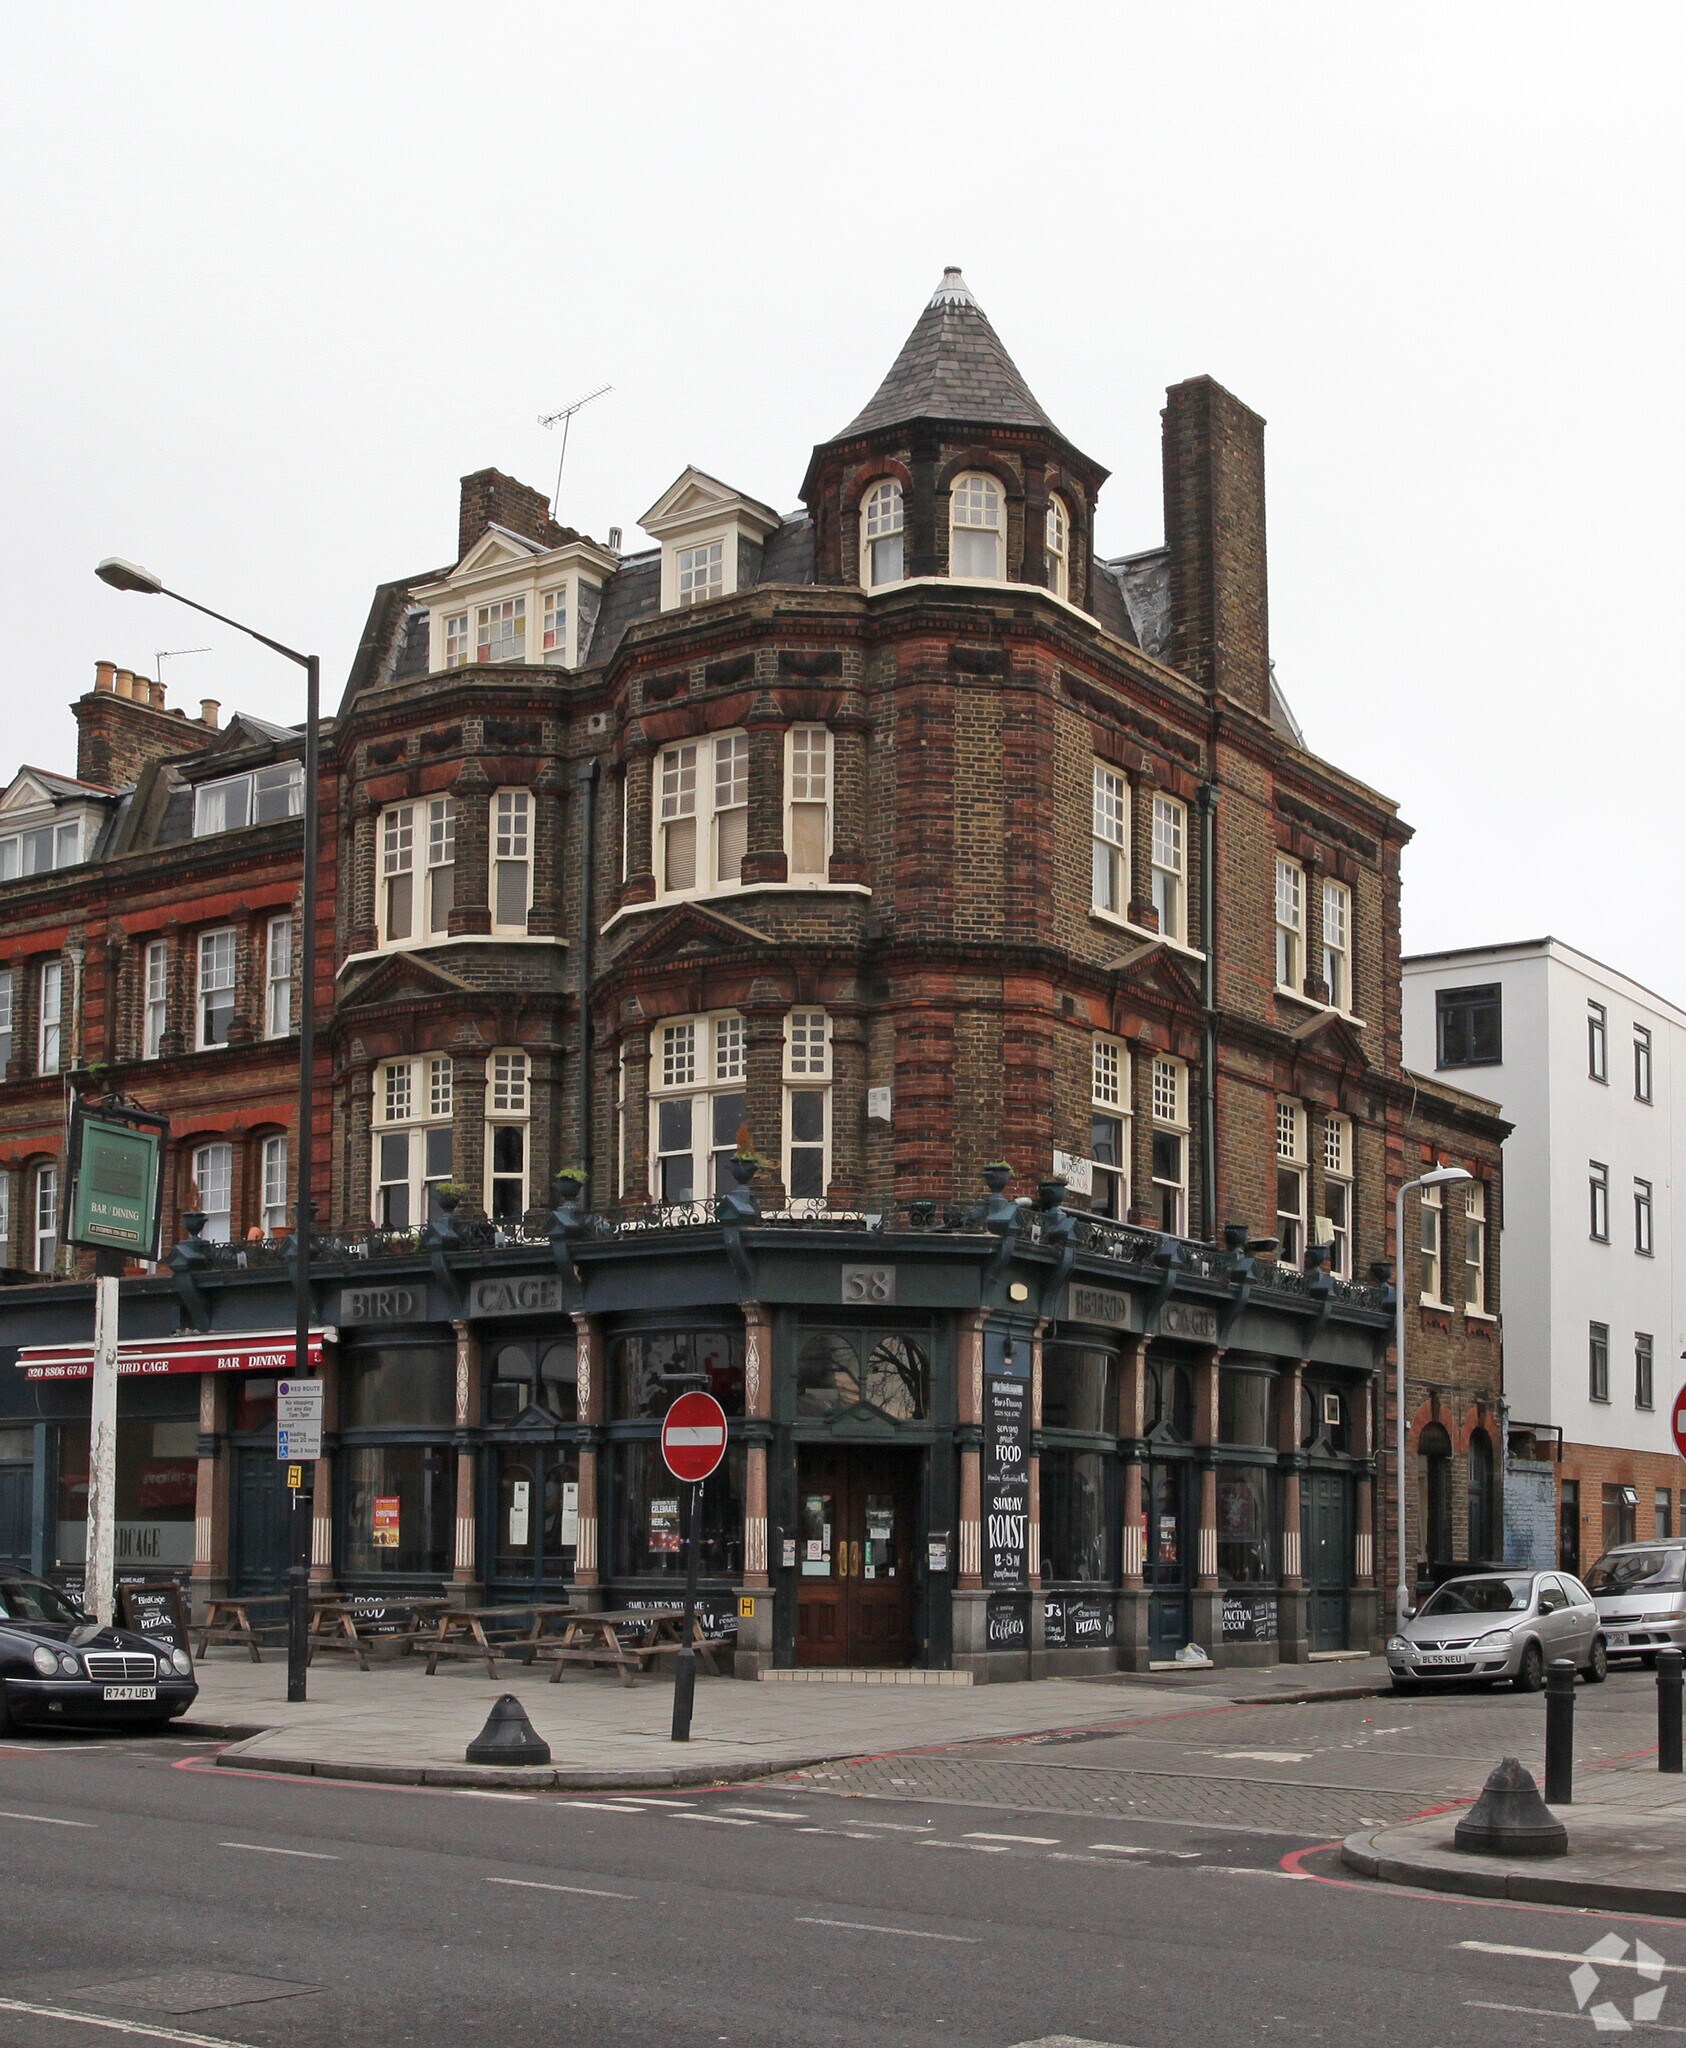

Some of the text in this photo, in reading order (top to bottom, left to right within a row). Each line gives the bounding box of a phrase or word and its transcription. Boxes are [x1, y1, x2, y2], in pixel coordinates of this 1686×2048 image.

[91, 1202, 107, 1215] BAR
[112, 1206, 139, 1220] DINING
[846, 1270, 890, 1301] 58
[349, 1279, 557, 1319] BIRD CAGE
[1075, 1289, 1216, 1337] BIRD CAGE
[27, 1354, 286, 1378] 020 8806 6740 BIRD CAGE BAR DINING
[995, 1444, 1022, 1462] FOOD
[289, 1468, 299, 1485] H
[652, 1505, 678, 1513] CELEBRATE
[992, 1496, 1023, 1511] SUNDAY
[987, 1513, 1028, 1549] ROAST
[742, 1599, 752, 1615] H
[140, 1615, 172, 1629] PIZZAS
[989, 1618, 1024, 1640] Coffees
[1075, 1618, 1102, 1634] PIZZAS
[1222, 1621, 1245, 1631] ROOM
[1422, 1655, 1462, 1664] BL55 NEU
[105, 1687, 155, 1699] R747 UBY
